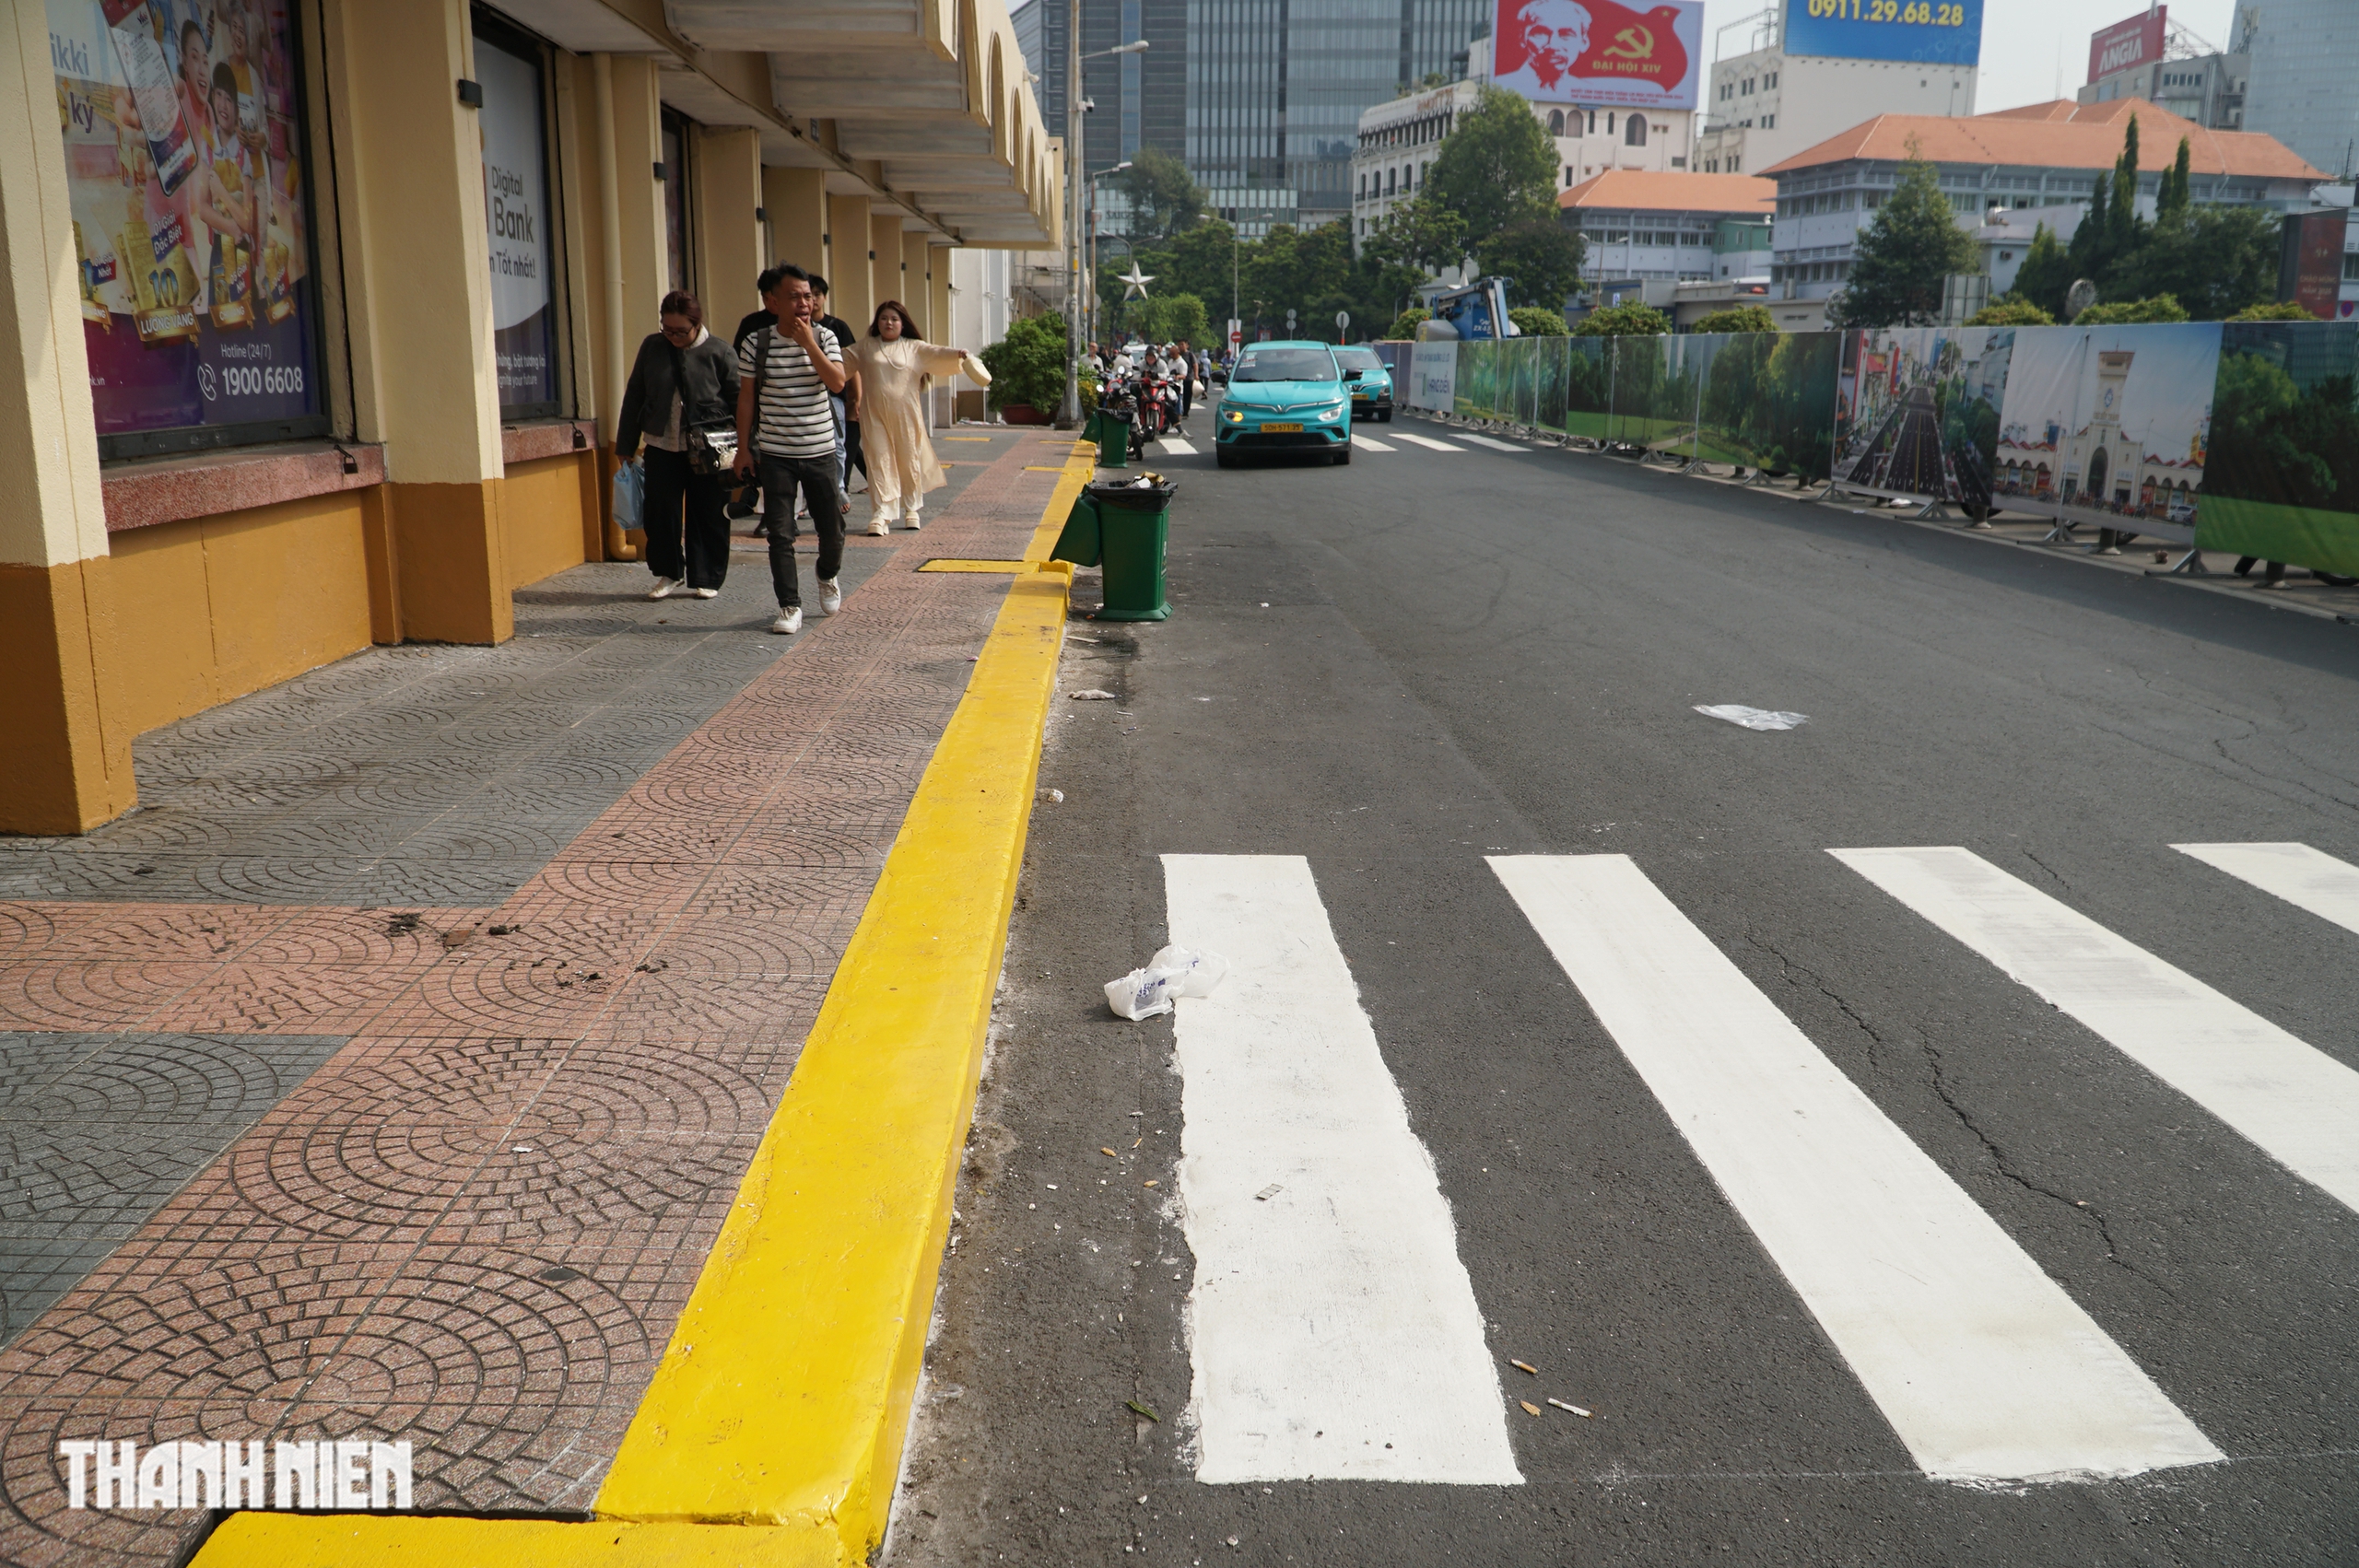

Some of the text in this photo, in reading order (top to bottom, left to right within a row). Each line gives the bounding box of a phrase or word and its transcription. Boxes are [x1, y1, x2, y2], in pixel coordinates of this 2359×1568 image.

[1808, 0, 1964, 27] 0911.29.68.28
[50, 32, 89, 76] ikki
[1592, 61, 1661, 74] ĐẠI HỘI XIV
[491, 166, 523, 198] Digital
[493, 197, 534, 243] Bank
[154, 224, 182, 255] Đặc Biệt
[496, 248, 511, 276] Tốt
[513, 252, 536, 279] nhất!
[140, 310, 195, 335] LƯỢNG VÀNG
[220, 344, 272, 361] Hotline (24/7)
[222, 367, 303, 396] 1900 6608
